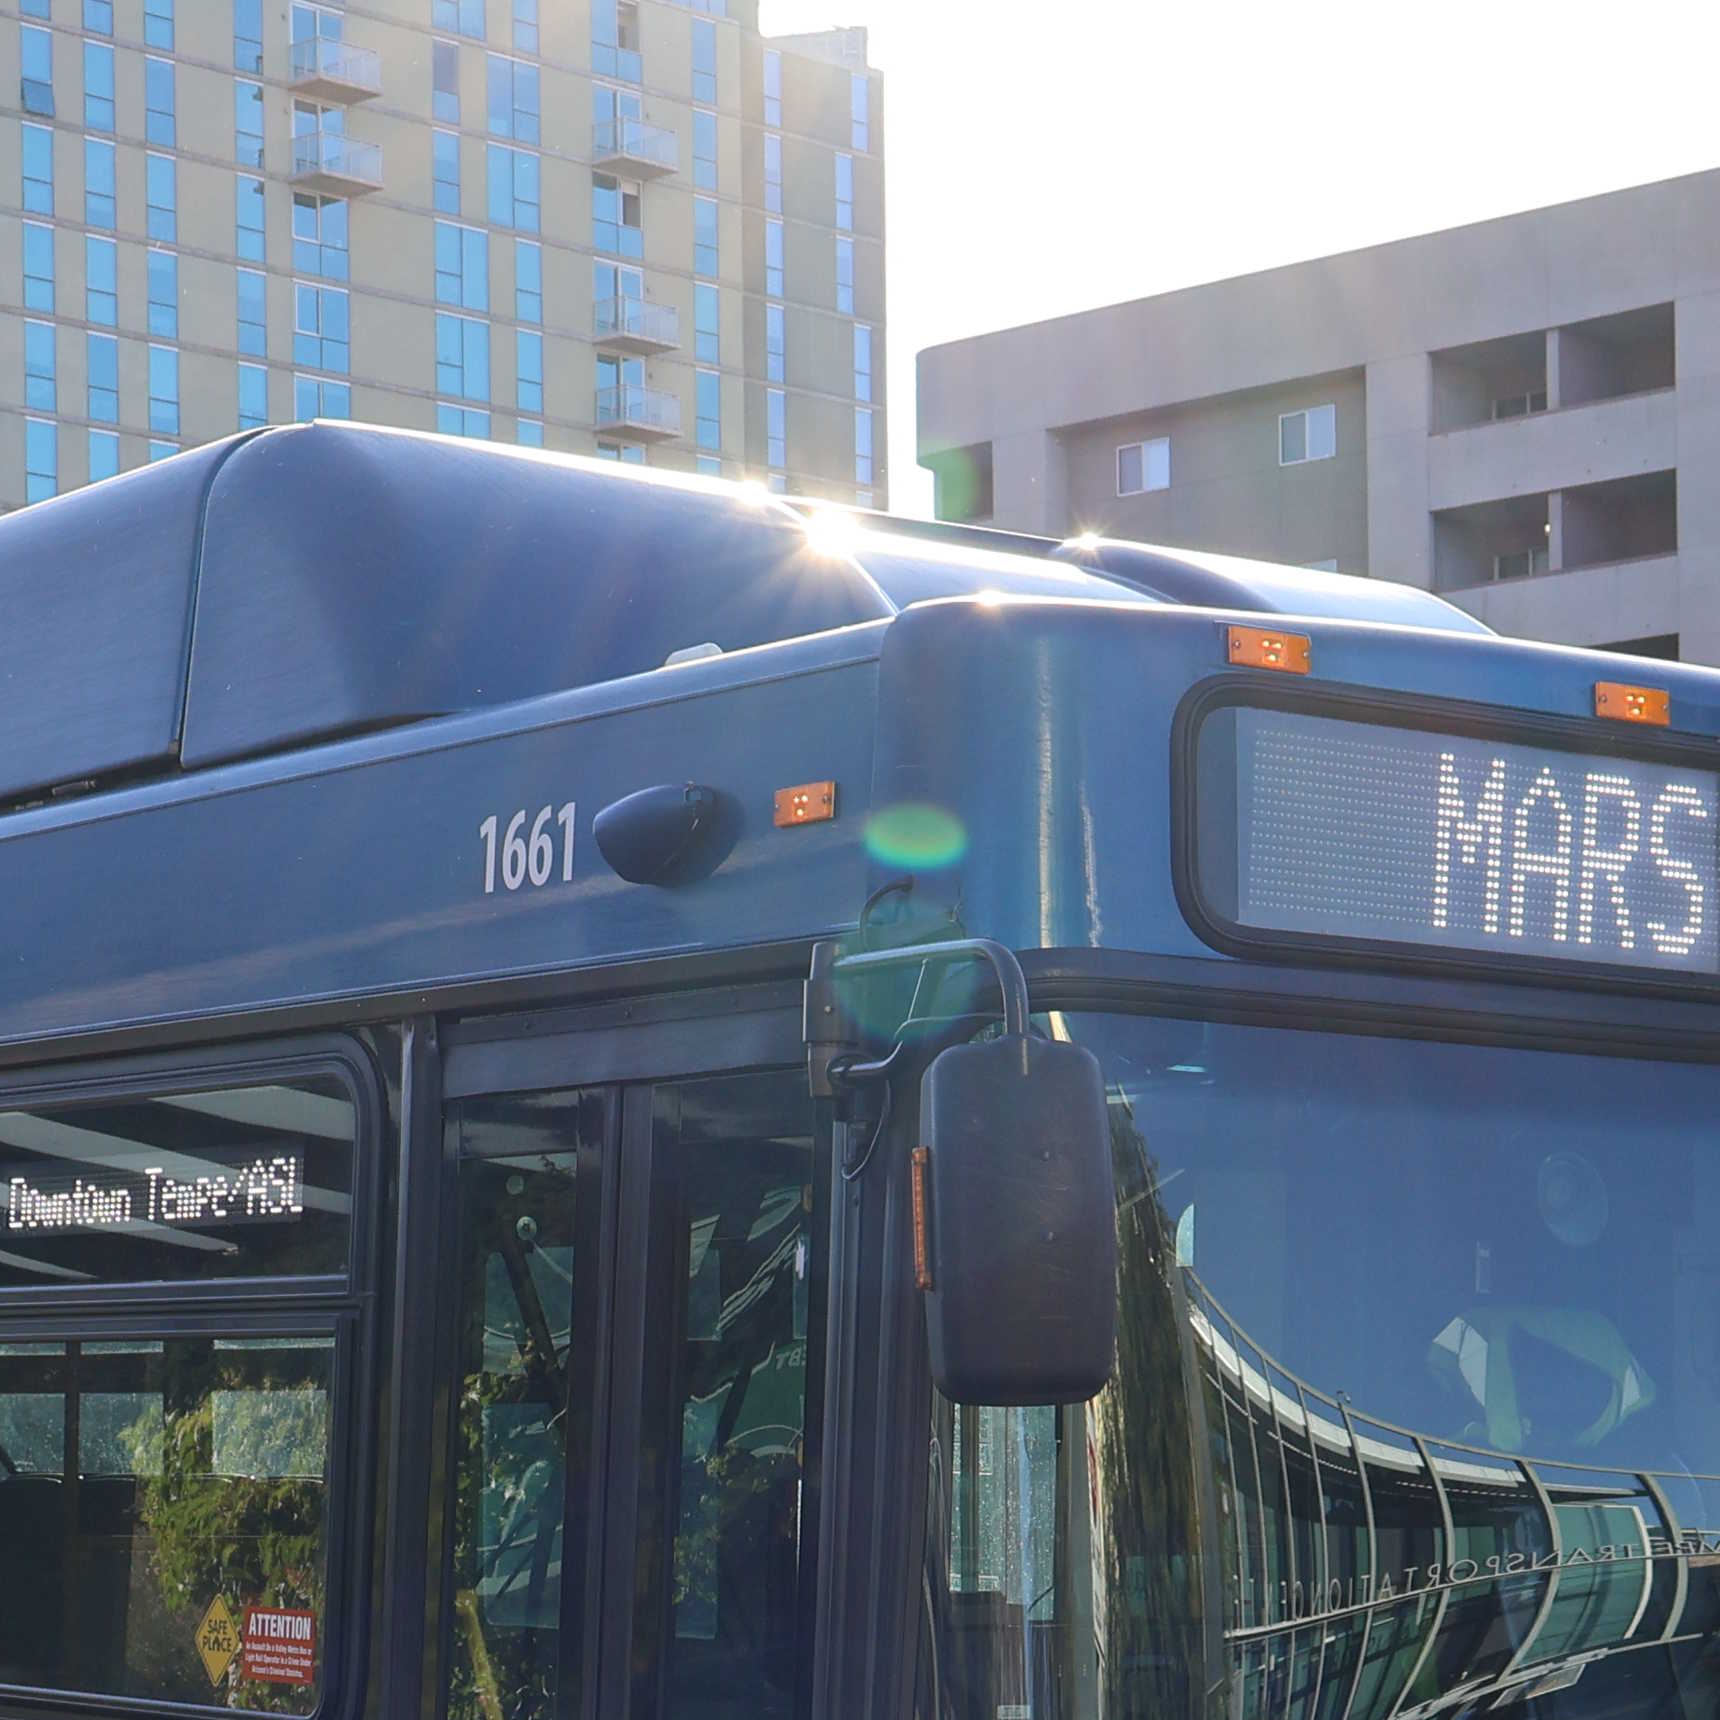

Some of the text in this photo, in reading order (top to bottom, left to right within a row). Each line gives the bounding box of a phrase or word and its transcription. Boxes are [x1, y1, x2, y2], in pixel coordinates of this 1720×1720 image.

[479, 801, 576, 895] 1661
[1431, 751, 1708, 956] MARS
[8, 1177, 132, 1228] Downtown
[202, 1635, 232, 1652] PLACE
[207, 1619, 228, 1635] SAFE
[248, 1612, 312, 1640] ATTENTION
